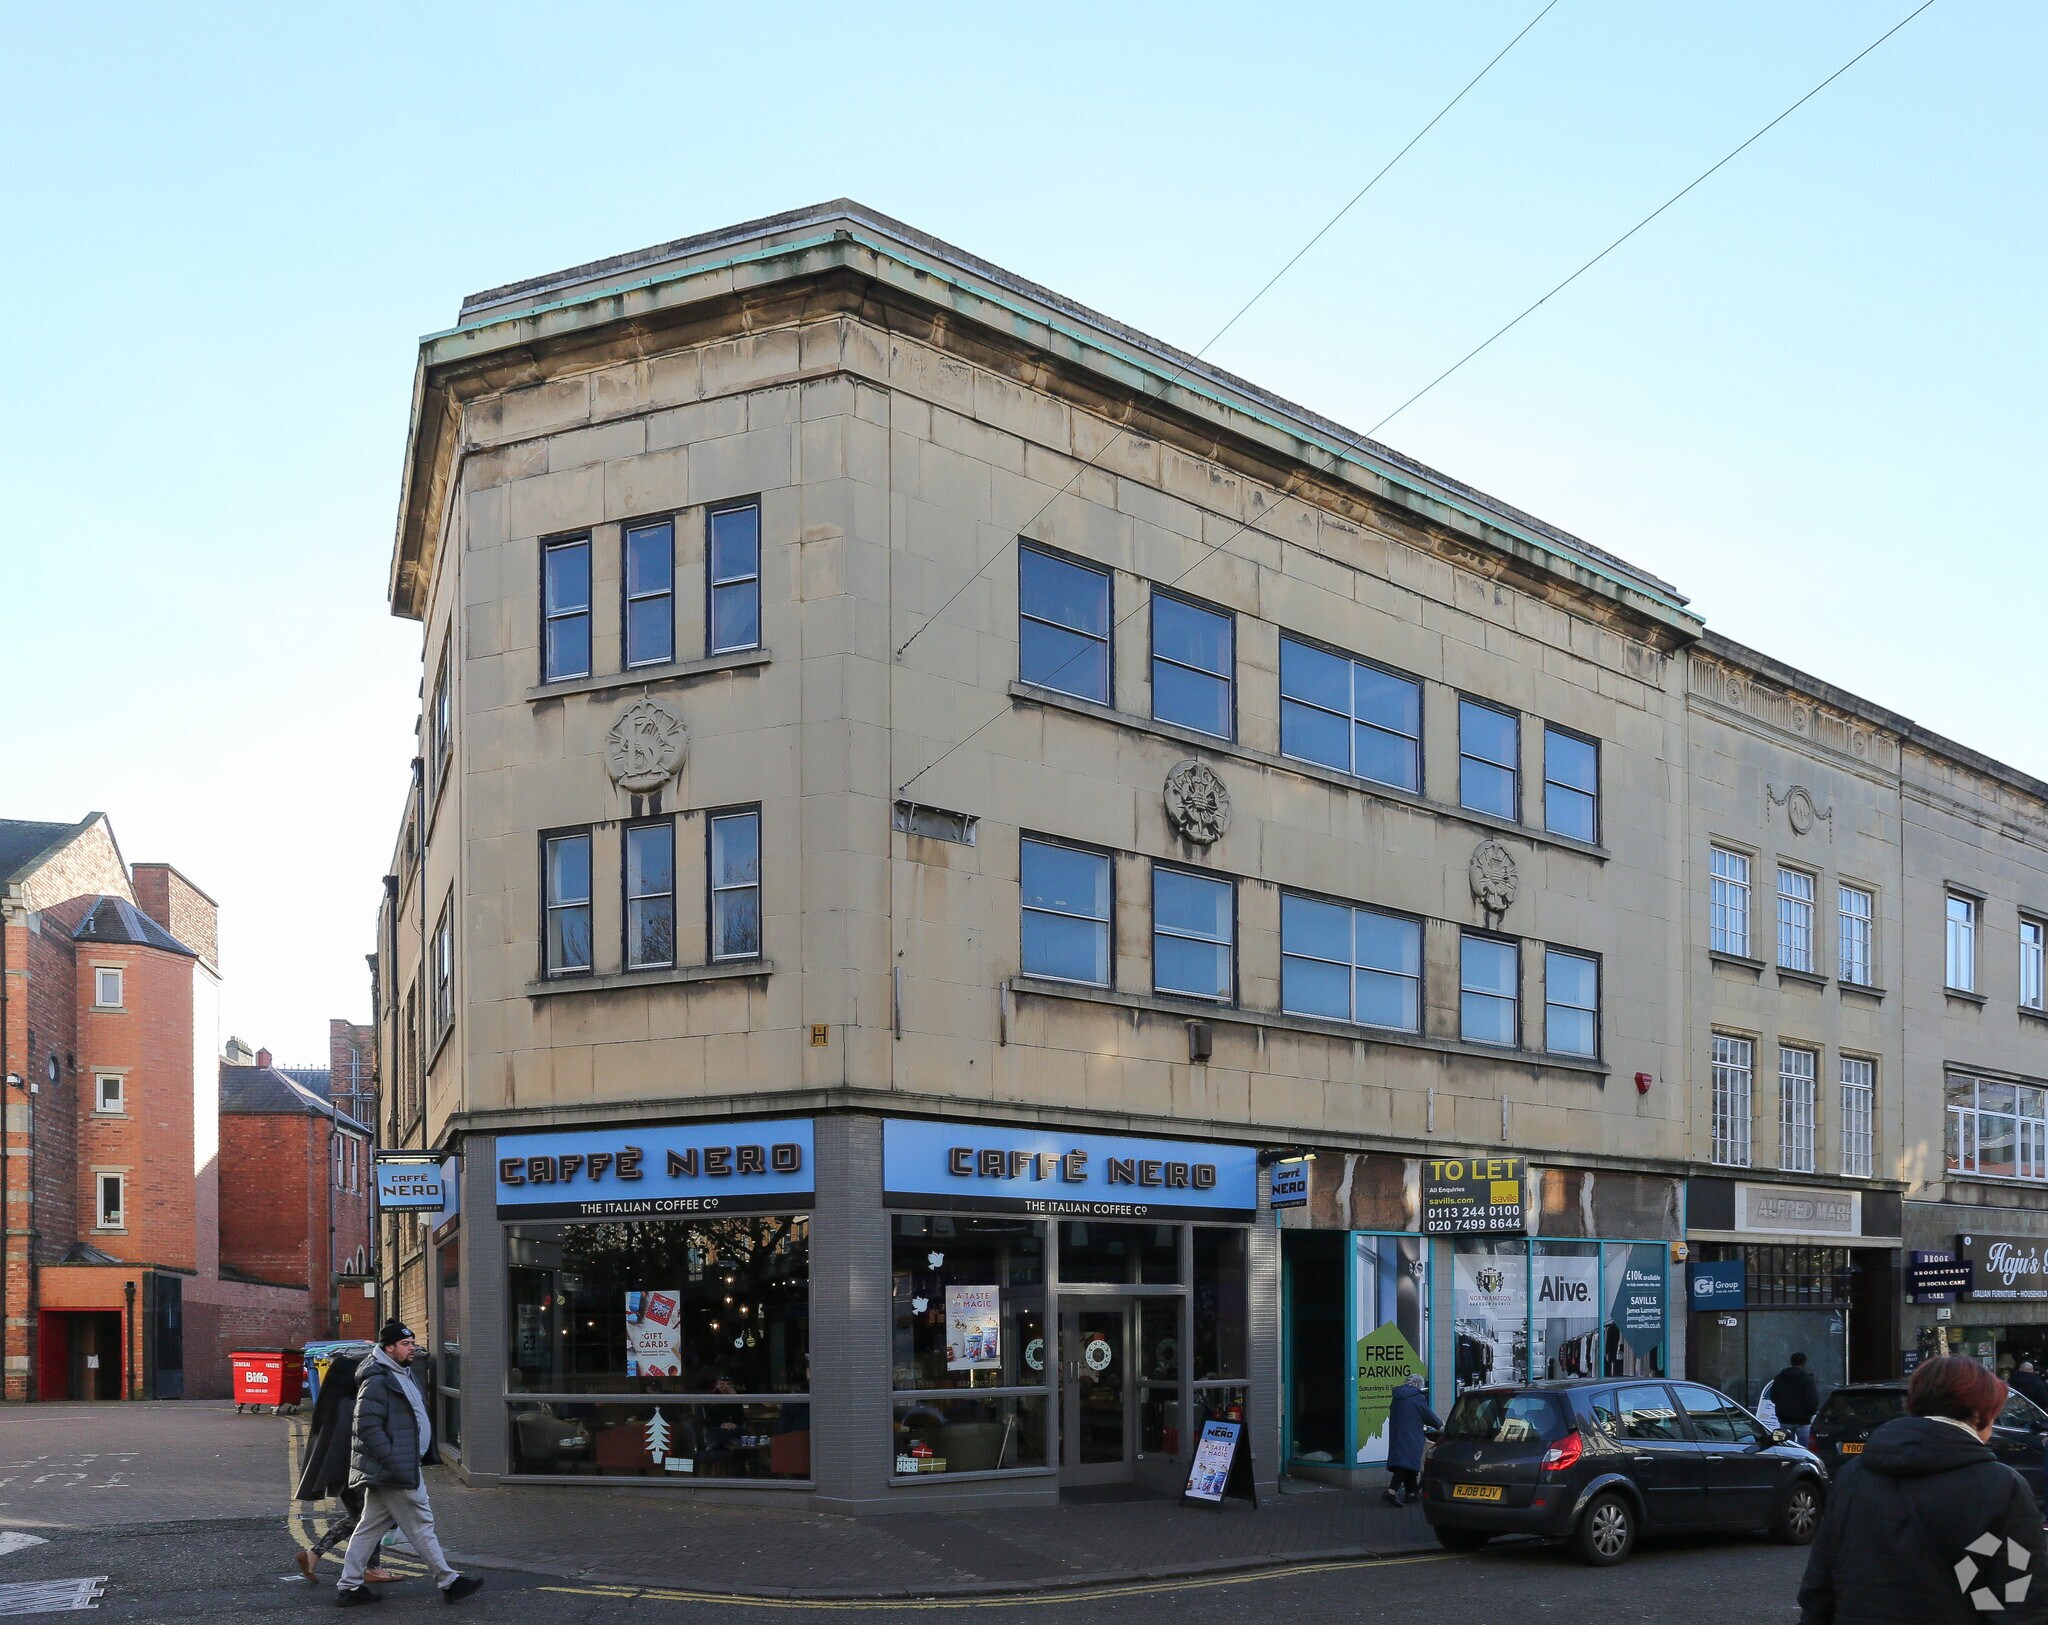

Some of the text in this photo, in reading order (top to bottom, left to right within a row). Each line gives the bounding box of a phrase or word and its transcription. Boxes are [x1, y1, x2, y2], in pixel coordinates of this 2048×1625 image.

[499, 1143, 802, 1186] CAFFÈ NERO
[949, 1147, 1216, 1188] CAFFÈ NERO
[1430, 1159, 1518, 1180] TO LET
[1278, 1168, 1300, 1179] CAFFÈ
[383, 1172, 438, 1196] CAFFÈ NERO
[1272, 1181, 1305, 1195] NERO
[1492, 1194, 1516, 1203] savills
[580, 1203, 601, 1214] THE
[606, 1202, 650, 1213] ITALIAN
[655, 1200, 699, 1211] COFFEE
[1025, 1201, 1045, 1211] THE
[1048, 1202, 1090, 1213] ITALIAN
[1094, 1204, 1131, 1215] COFFEE
[1429, 1205, 1519, 1218] 0113 244 0100
[1757, 1198, 1814, 1220] ALFRED
[1429, 1218, 1520, 1231] 020 7499 8644
[1627, 1270, 1643, 1280] £10k
[1539, 1276, 1591, 1301] Alive.
[1715, 1281, 1738, 1289] Group
[1631, 1296, 1657, 1305] SAVILLS
[1992, 1290, 2016, 1298] FURNITURE
[2020, 1290, 2048, 1298] HOUSEHOLD
[1366, 1346, 1404, 1361] FREE
[246, 1371, 268, 1383] Biffa
[1359, 1365, 1411, 1378] PARKING
[1359, 1385, 1384, 1393] Saturdays
[1208, 1429, 1233, 1438] NERO
